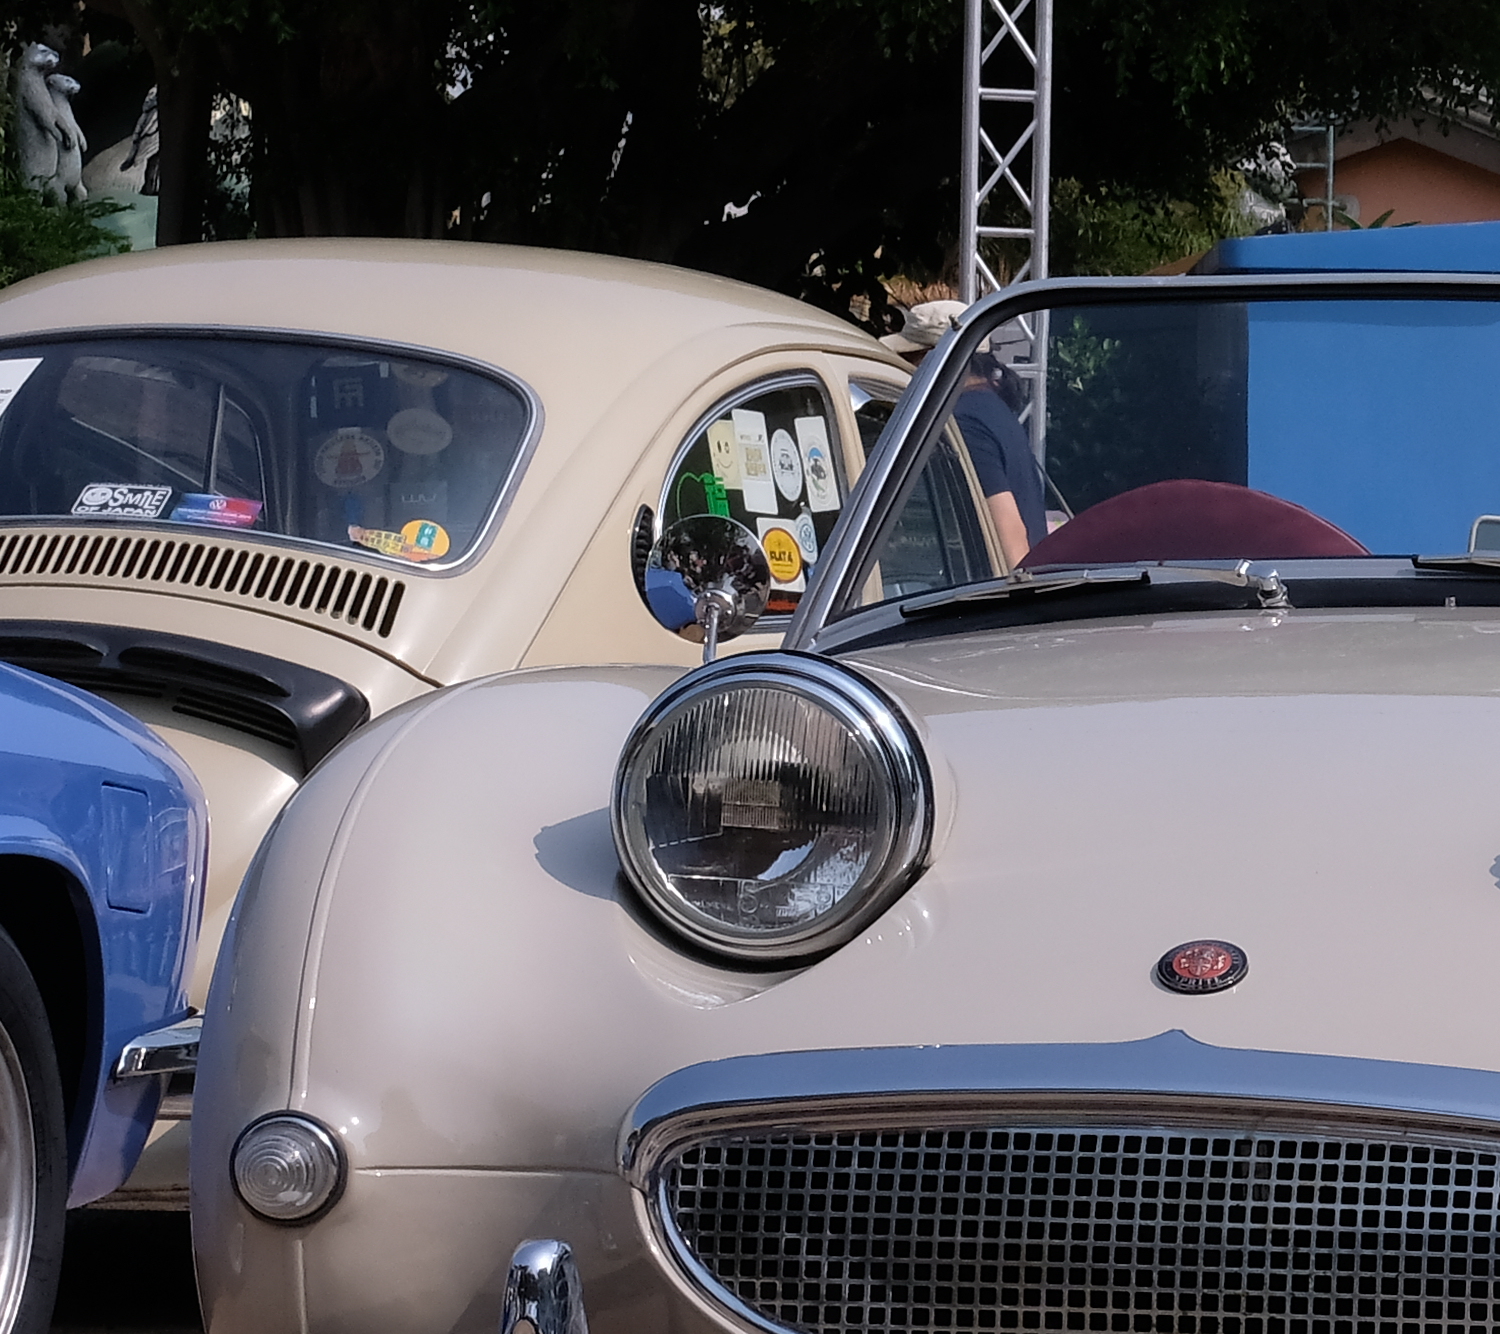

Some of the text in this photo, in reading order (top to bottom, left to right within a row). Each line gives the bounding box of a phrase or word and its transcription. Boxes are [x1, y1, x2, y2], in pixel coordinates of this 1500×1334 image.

[108, 487, 167, 508] SMILE
[75, 506, 158, 516] OF JAPAN
